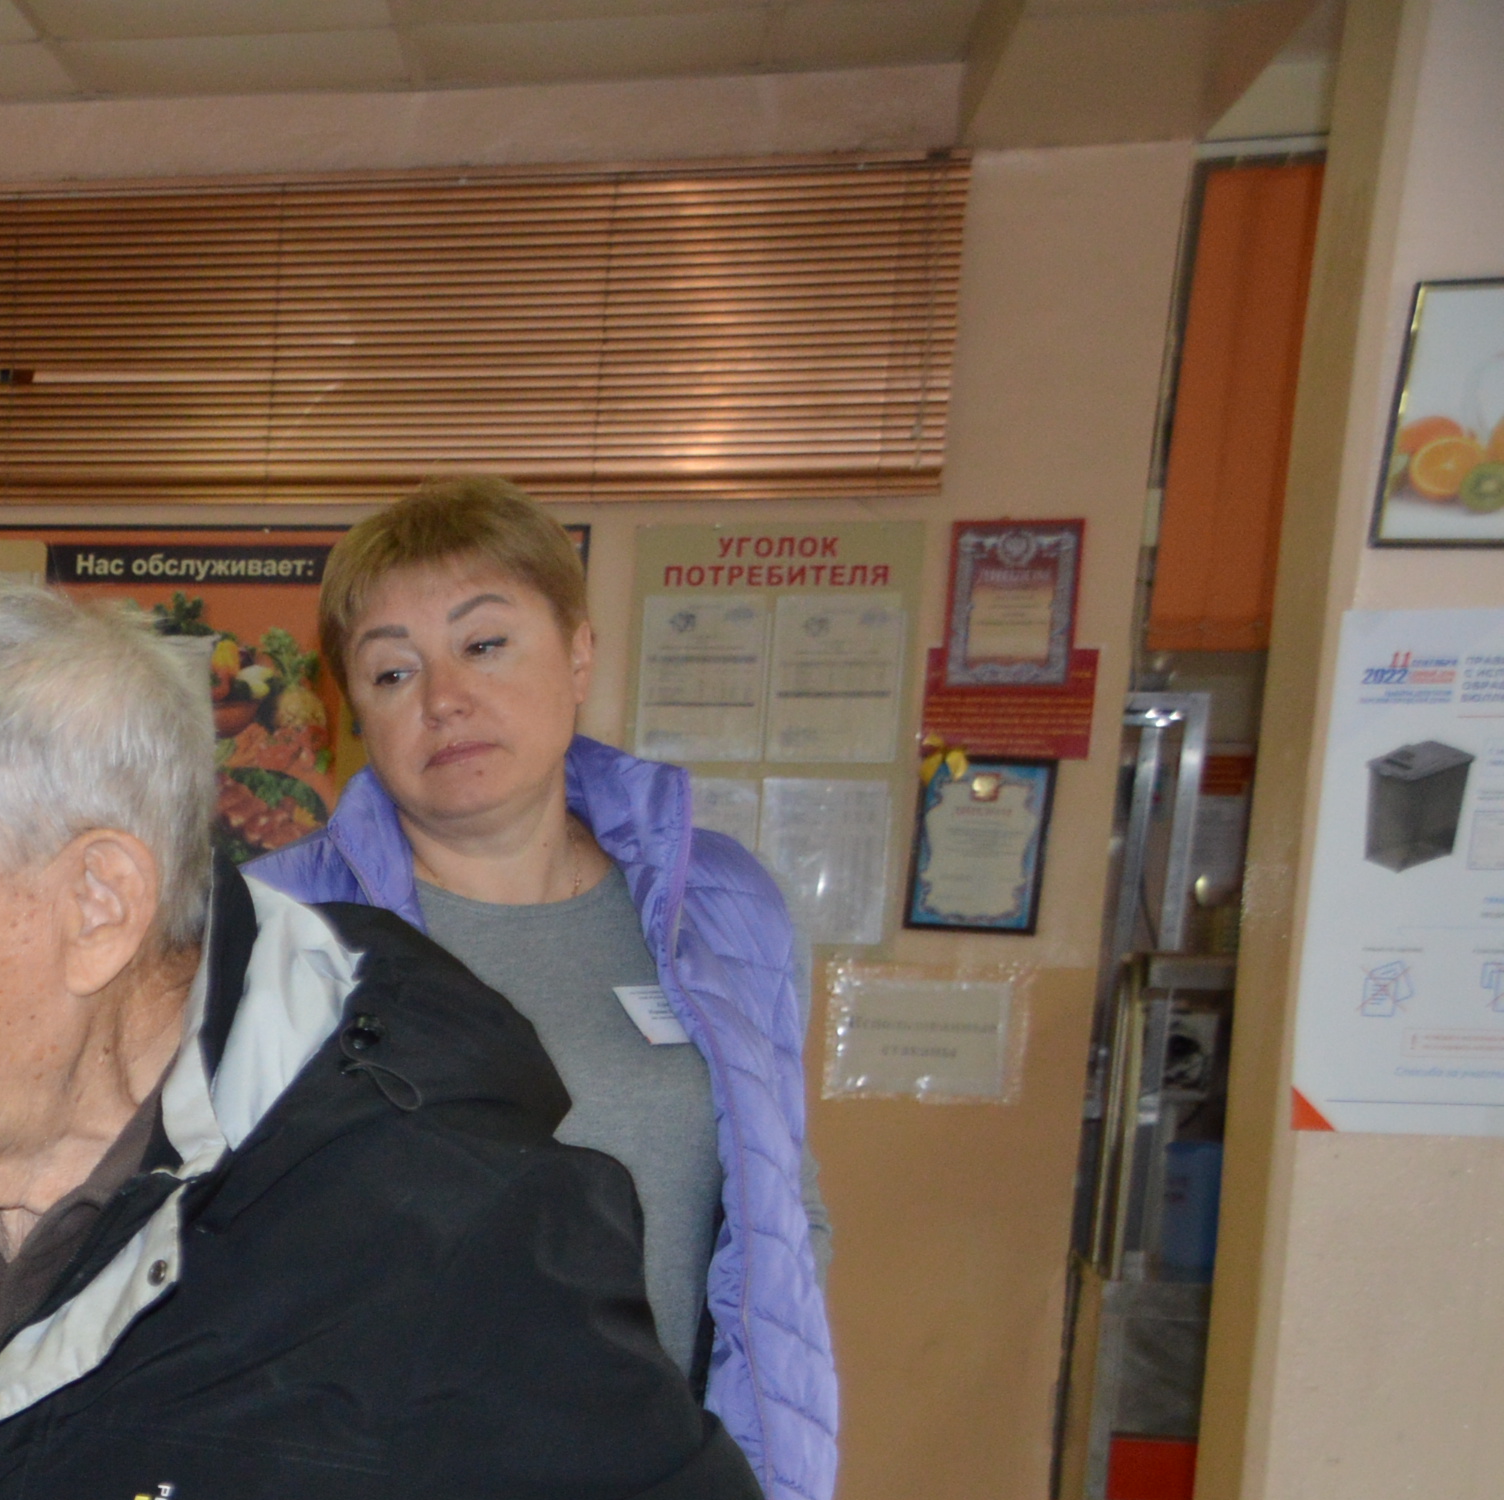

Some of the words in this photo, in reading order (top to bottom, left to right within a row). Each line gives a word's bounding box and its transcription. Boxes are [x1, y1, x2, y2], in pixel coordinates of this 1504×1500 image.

[717, 536, 839, 558] УГОЛОК
[75, 553, 124, 577] Нас
[131, 553, 314, 581] обслуживает:
[663, 564, 890, 587] ПОТРЕБИТЕЛЯ
[1390, 651, 1413, 668] 11
[1361, 668, 1409, 685] 2022
